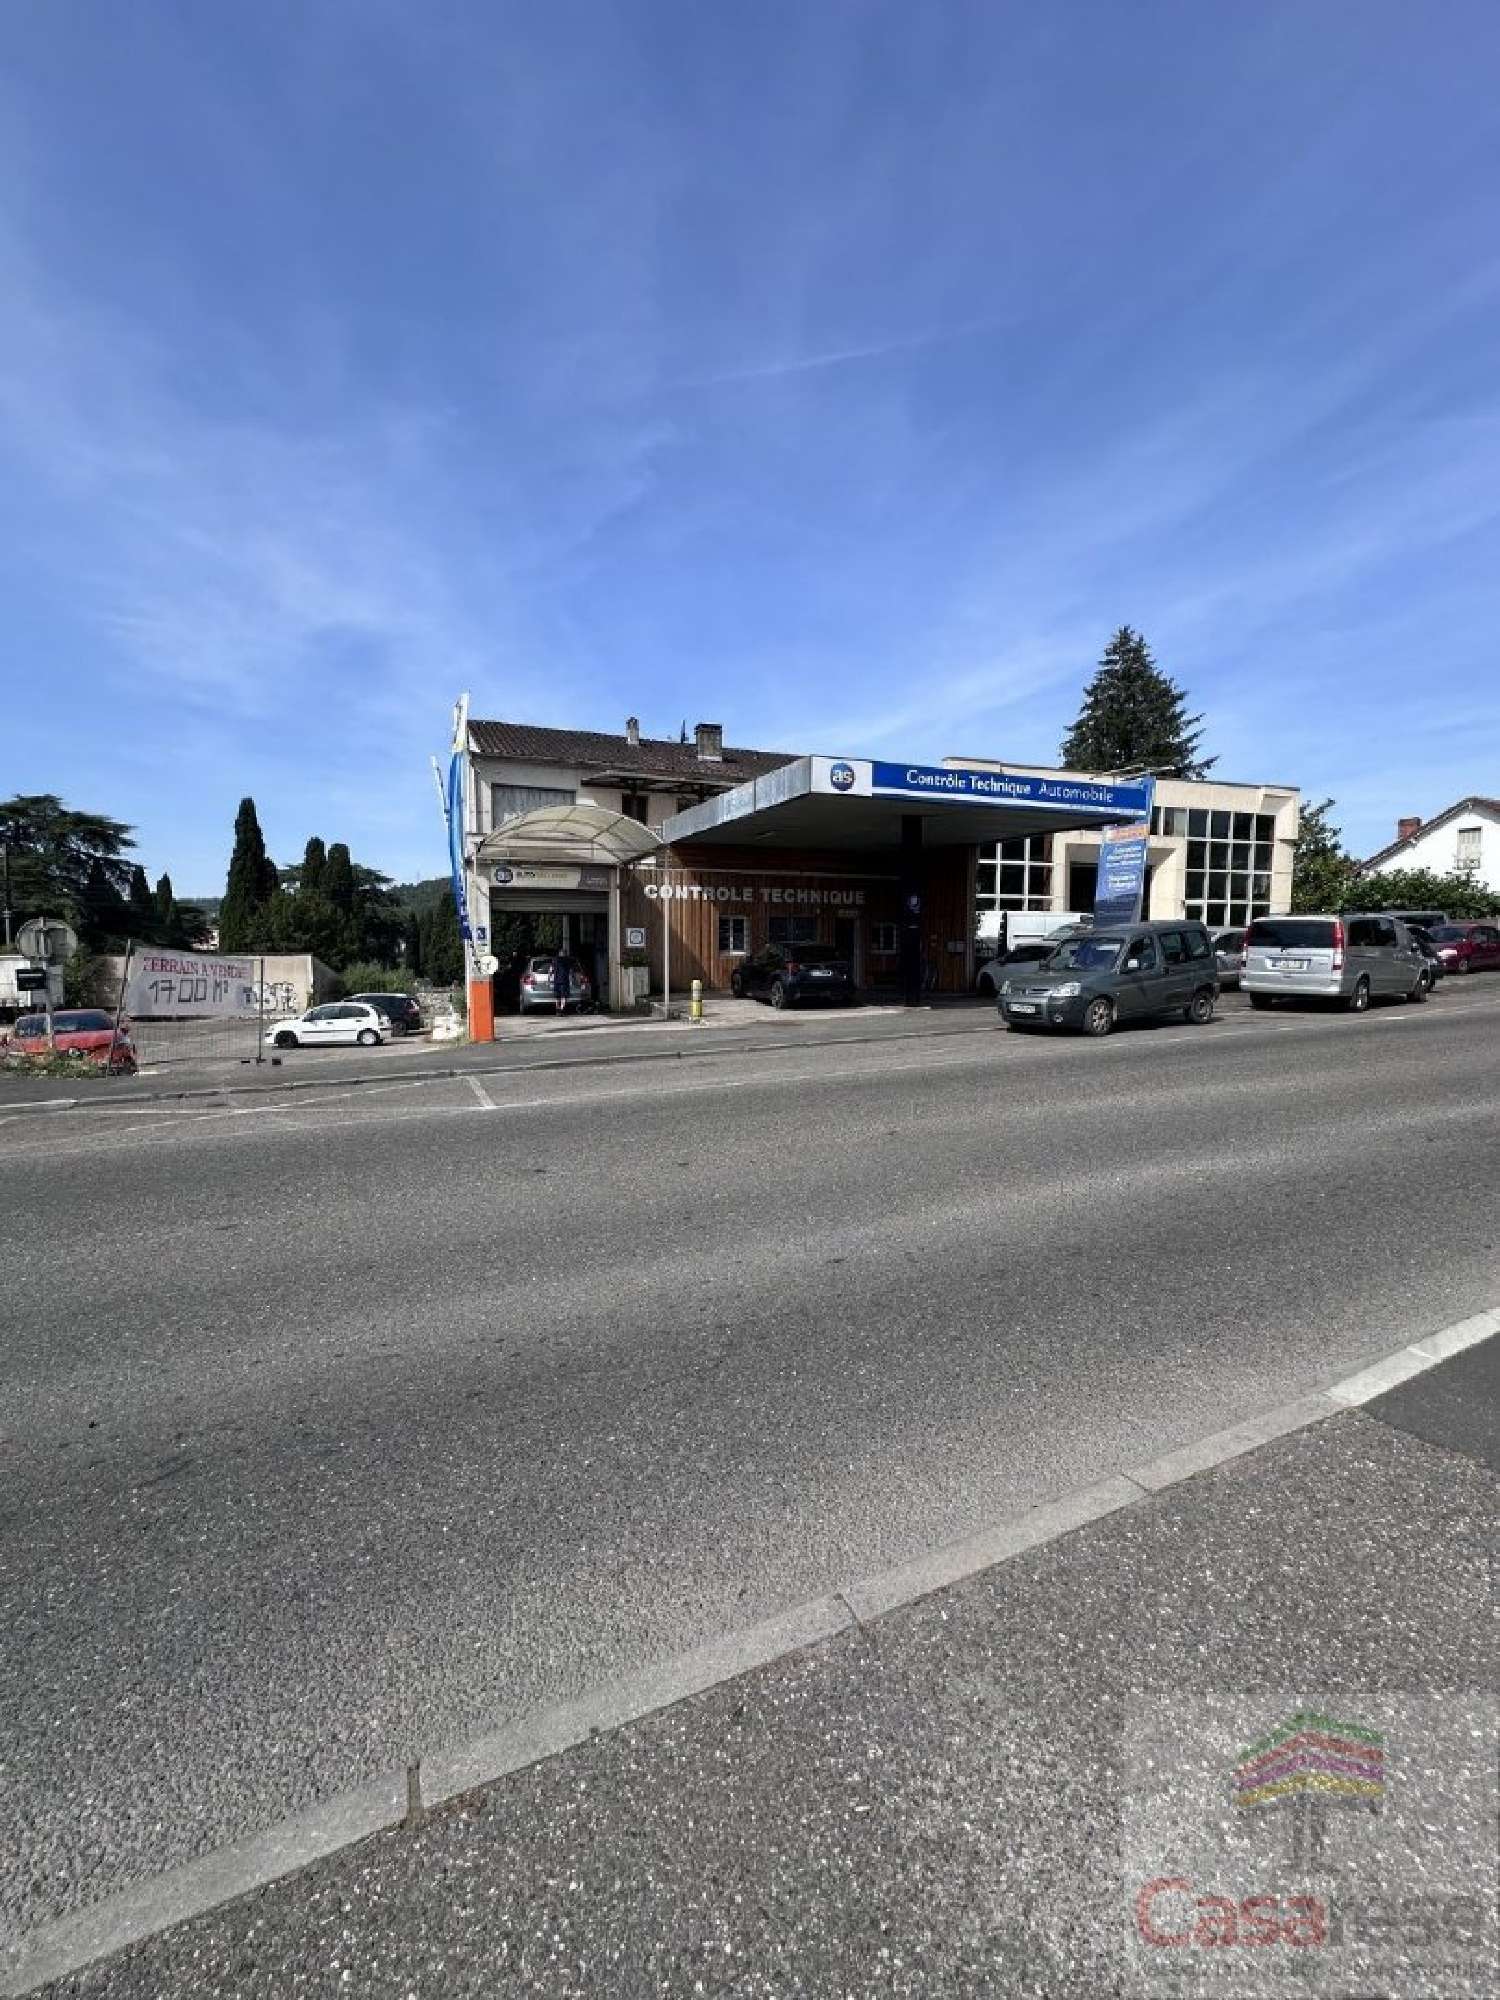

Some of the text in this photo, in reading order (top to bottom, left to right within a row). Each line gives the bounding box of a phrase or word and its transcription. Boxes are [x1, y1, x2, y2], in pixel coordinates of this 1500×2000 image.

[906, 769, 1114, 803] Contrôle Technique Automobile
[643, 884, 865, 905] CONTROLE TECHNIQUE
[148, 977, 208, 1005] 1700
